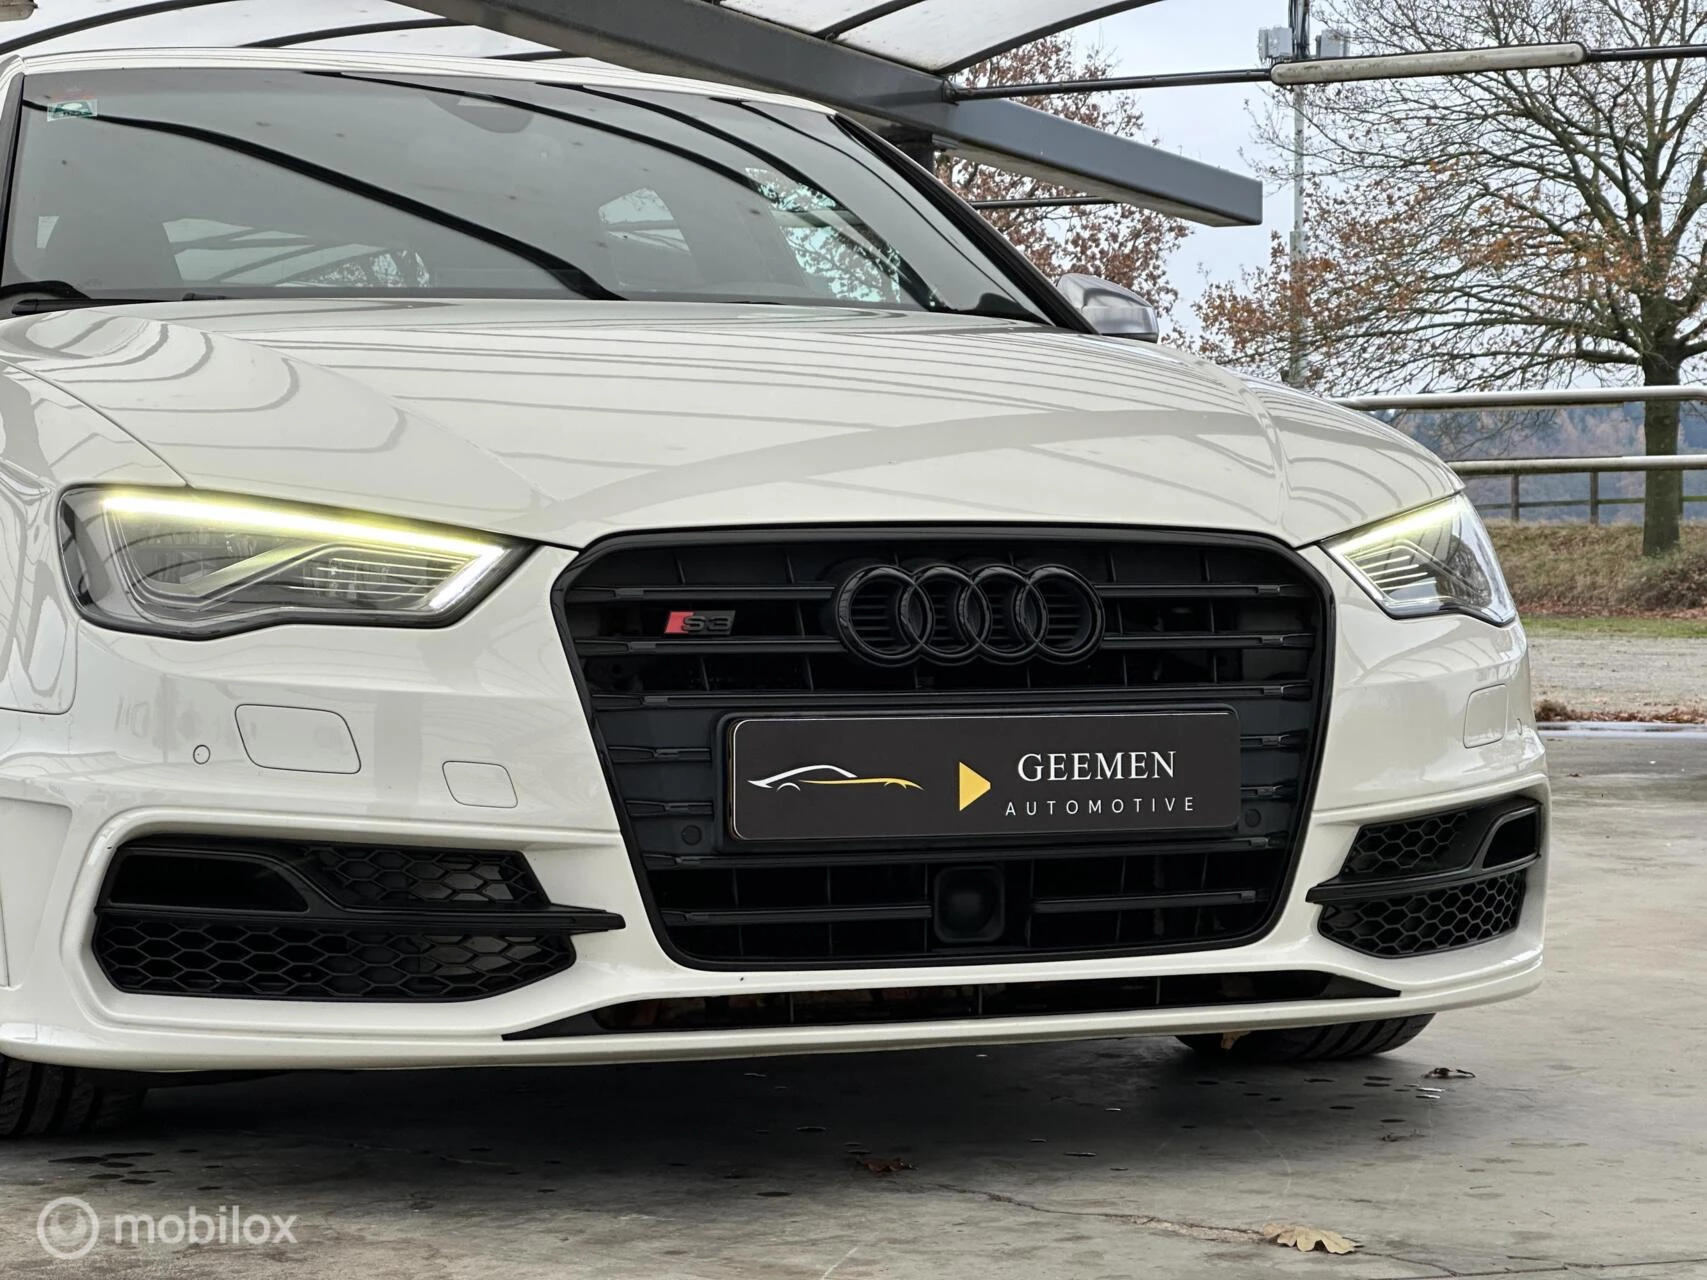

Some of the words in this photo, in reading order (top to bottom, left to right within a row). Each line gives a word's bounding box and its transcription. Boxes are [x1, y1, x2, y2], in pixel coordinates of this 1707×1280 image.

[682, 615, 731, 631] S3
[1017, 751, 1177, 782] GEEMEN
[1005, 796, 1195, 817] AUTOMOTIVE
